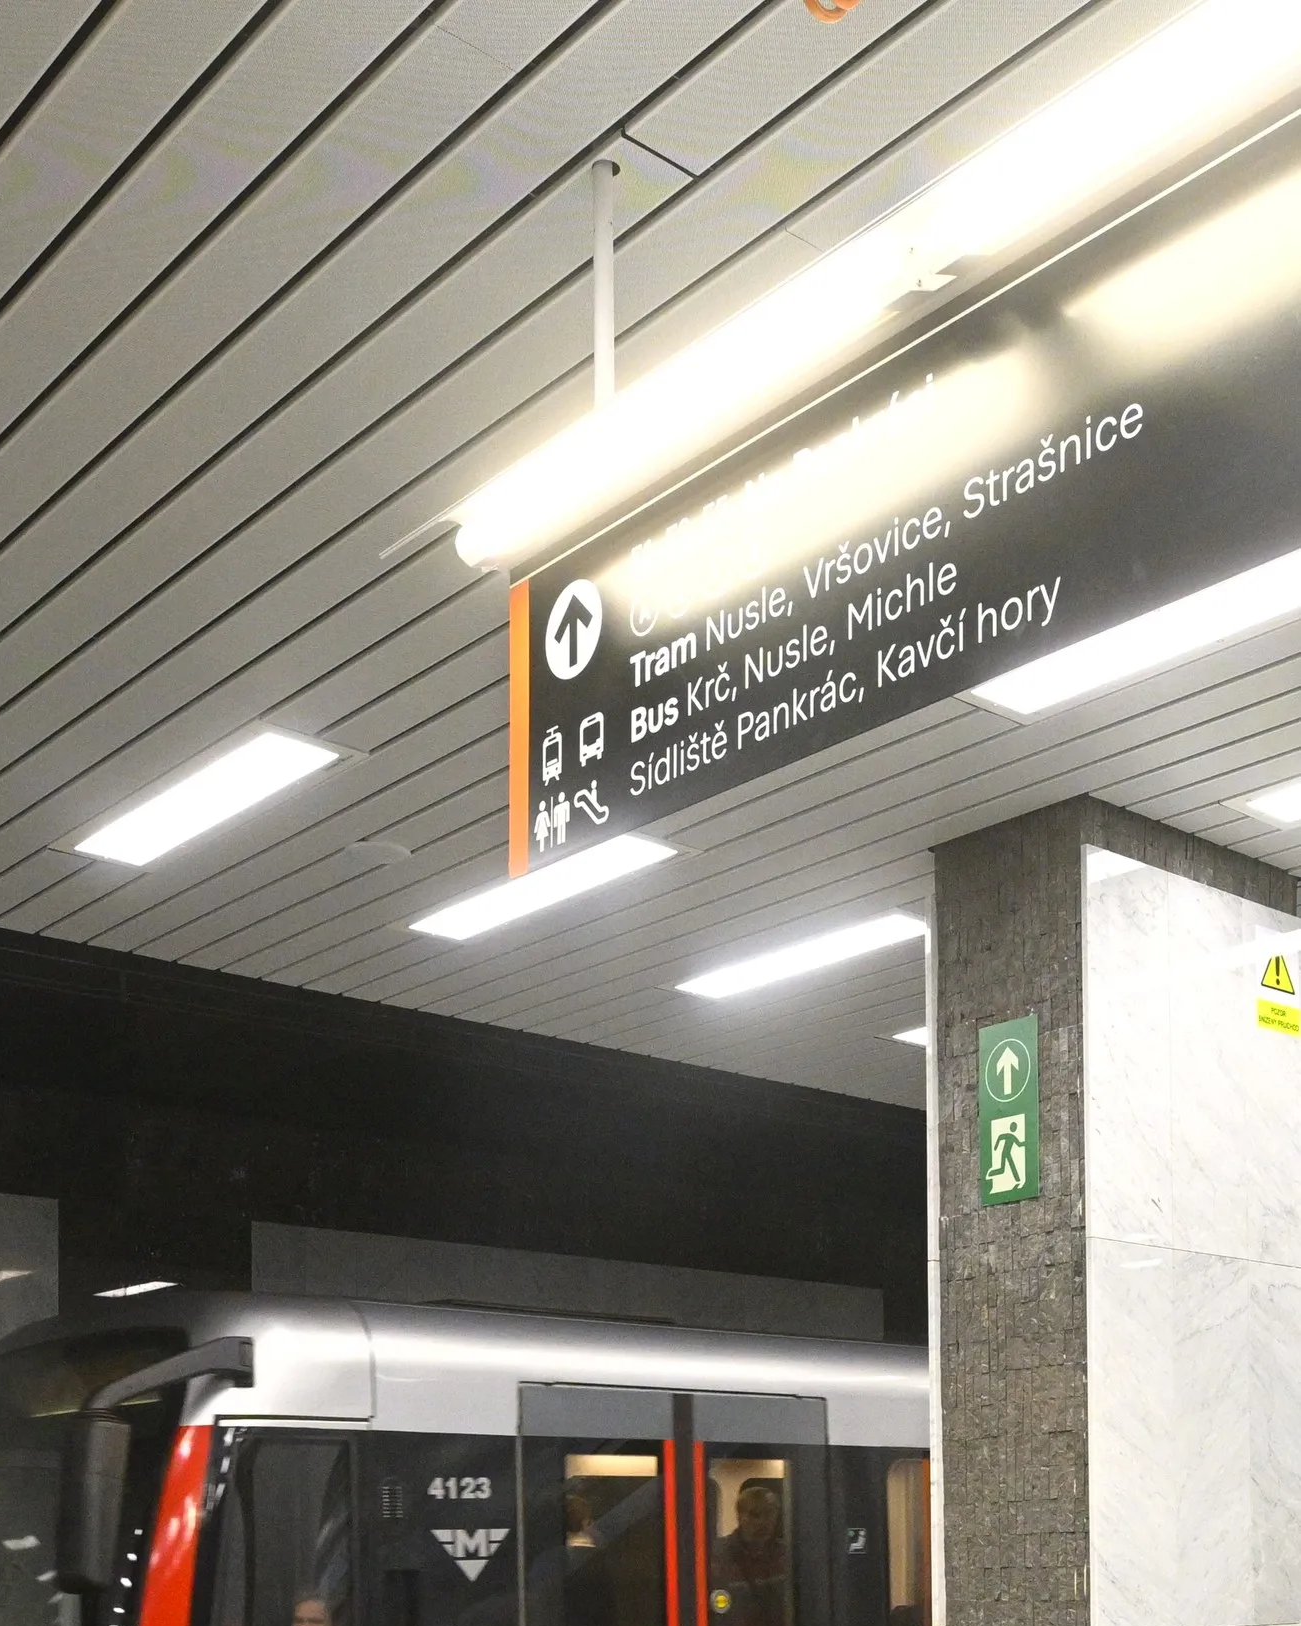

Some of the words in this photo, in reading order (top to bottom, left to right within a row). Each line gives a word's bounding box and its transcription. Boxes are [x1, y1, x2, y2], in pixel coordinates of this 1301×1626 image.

[629, 632, 697, 688] Tram
[705, 585, 793, 651] Nusle,
[802, 506, 951, 599] Vršovice,
[962, 402, 1144, 519] Strašnice
[629, 719, 728, 796] Sídliště
[737, 669, 865, 750] Pankrác,
[877, 606, 967, 688] Kavčí
[977, 576, 1061, 643] hory
[630, 697, 679, 743] Bus
[687, 660, 737, 716] Krč,
[744, 623, 835, 689] Nusle,
[847, 561, 958, 641] Michle
[427, 1477, 492, 1500] 4123
